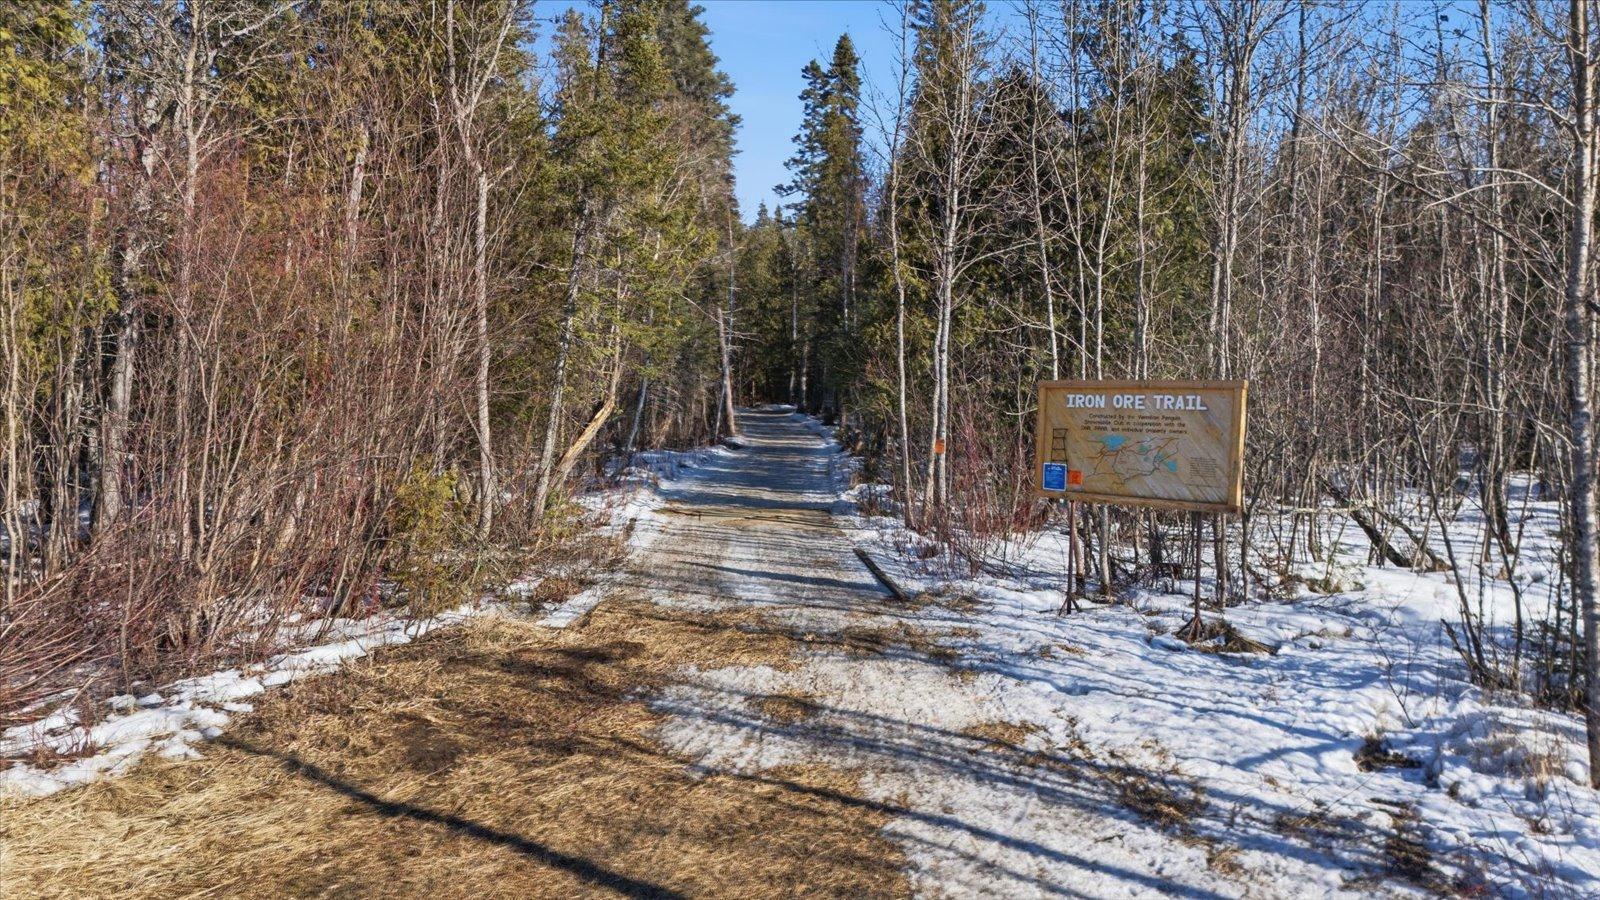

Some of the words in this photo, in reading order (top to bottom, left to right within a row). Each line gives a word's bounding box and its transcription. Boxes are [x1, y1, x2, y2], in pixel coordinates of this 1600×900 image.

[1066, 394, 1105, 408] IRON
[1112, 395, 1146, 410] ORE
[1153, 395, 1208, 411] TRAIL
